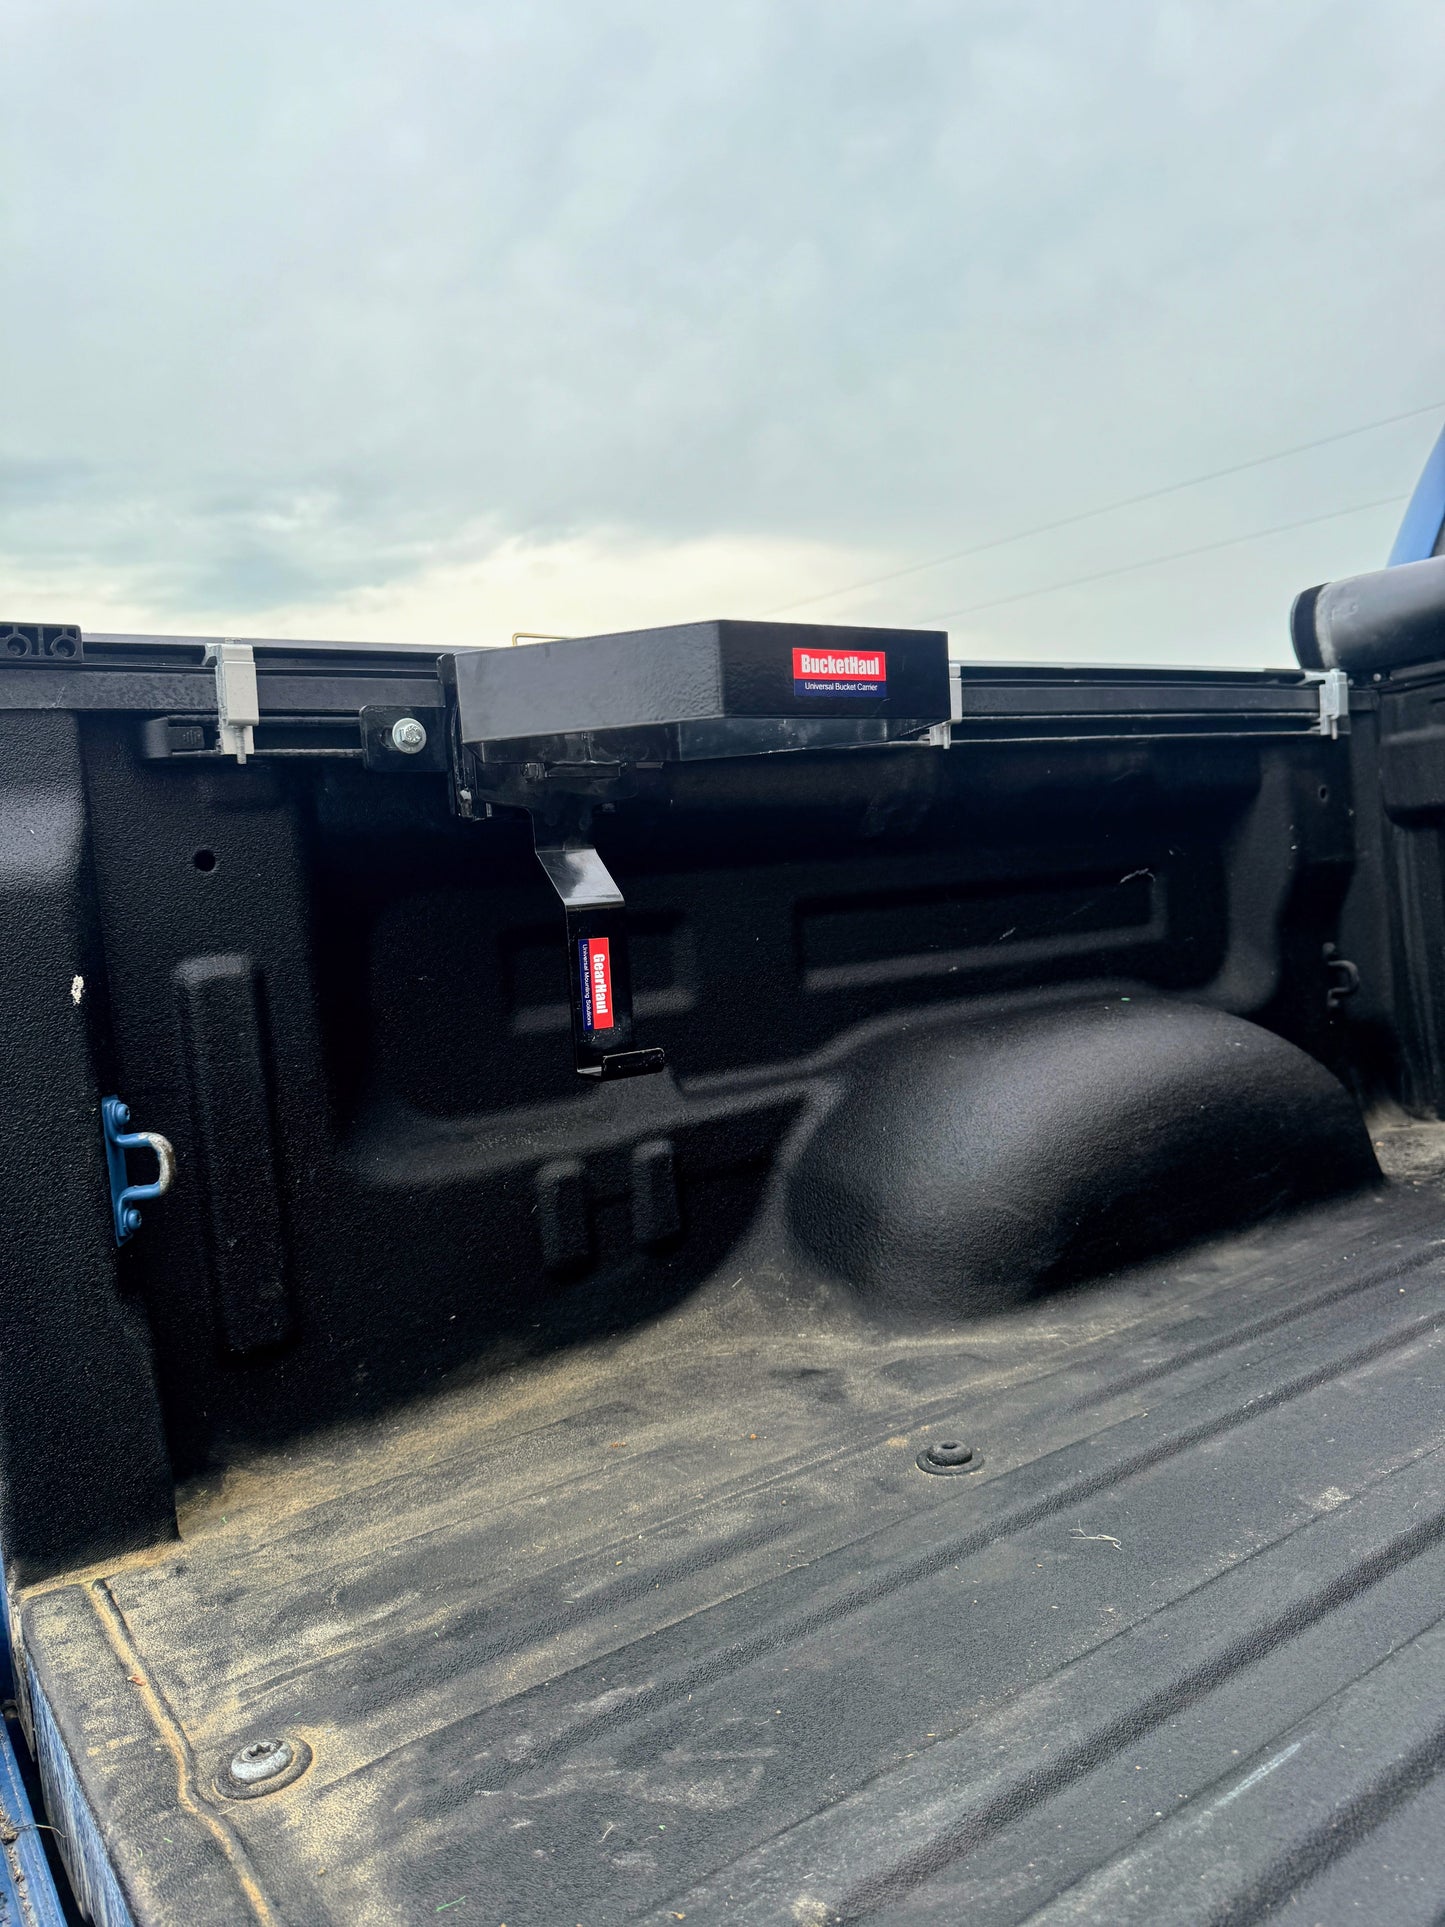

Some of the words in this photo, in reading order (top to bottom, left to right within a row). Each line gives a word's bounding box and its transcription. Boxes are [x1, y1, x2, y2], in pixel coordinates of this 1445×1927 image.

[801, 654, 879, 675] BucketHaul
[804, 682, 834, 690] Universal
[835, 682, 856, 691] Bucket
[857, 683, 877, 691] Carrier
[593, 953, 608, 1014] GearHaul
